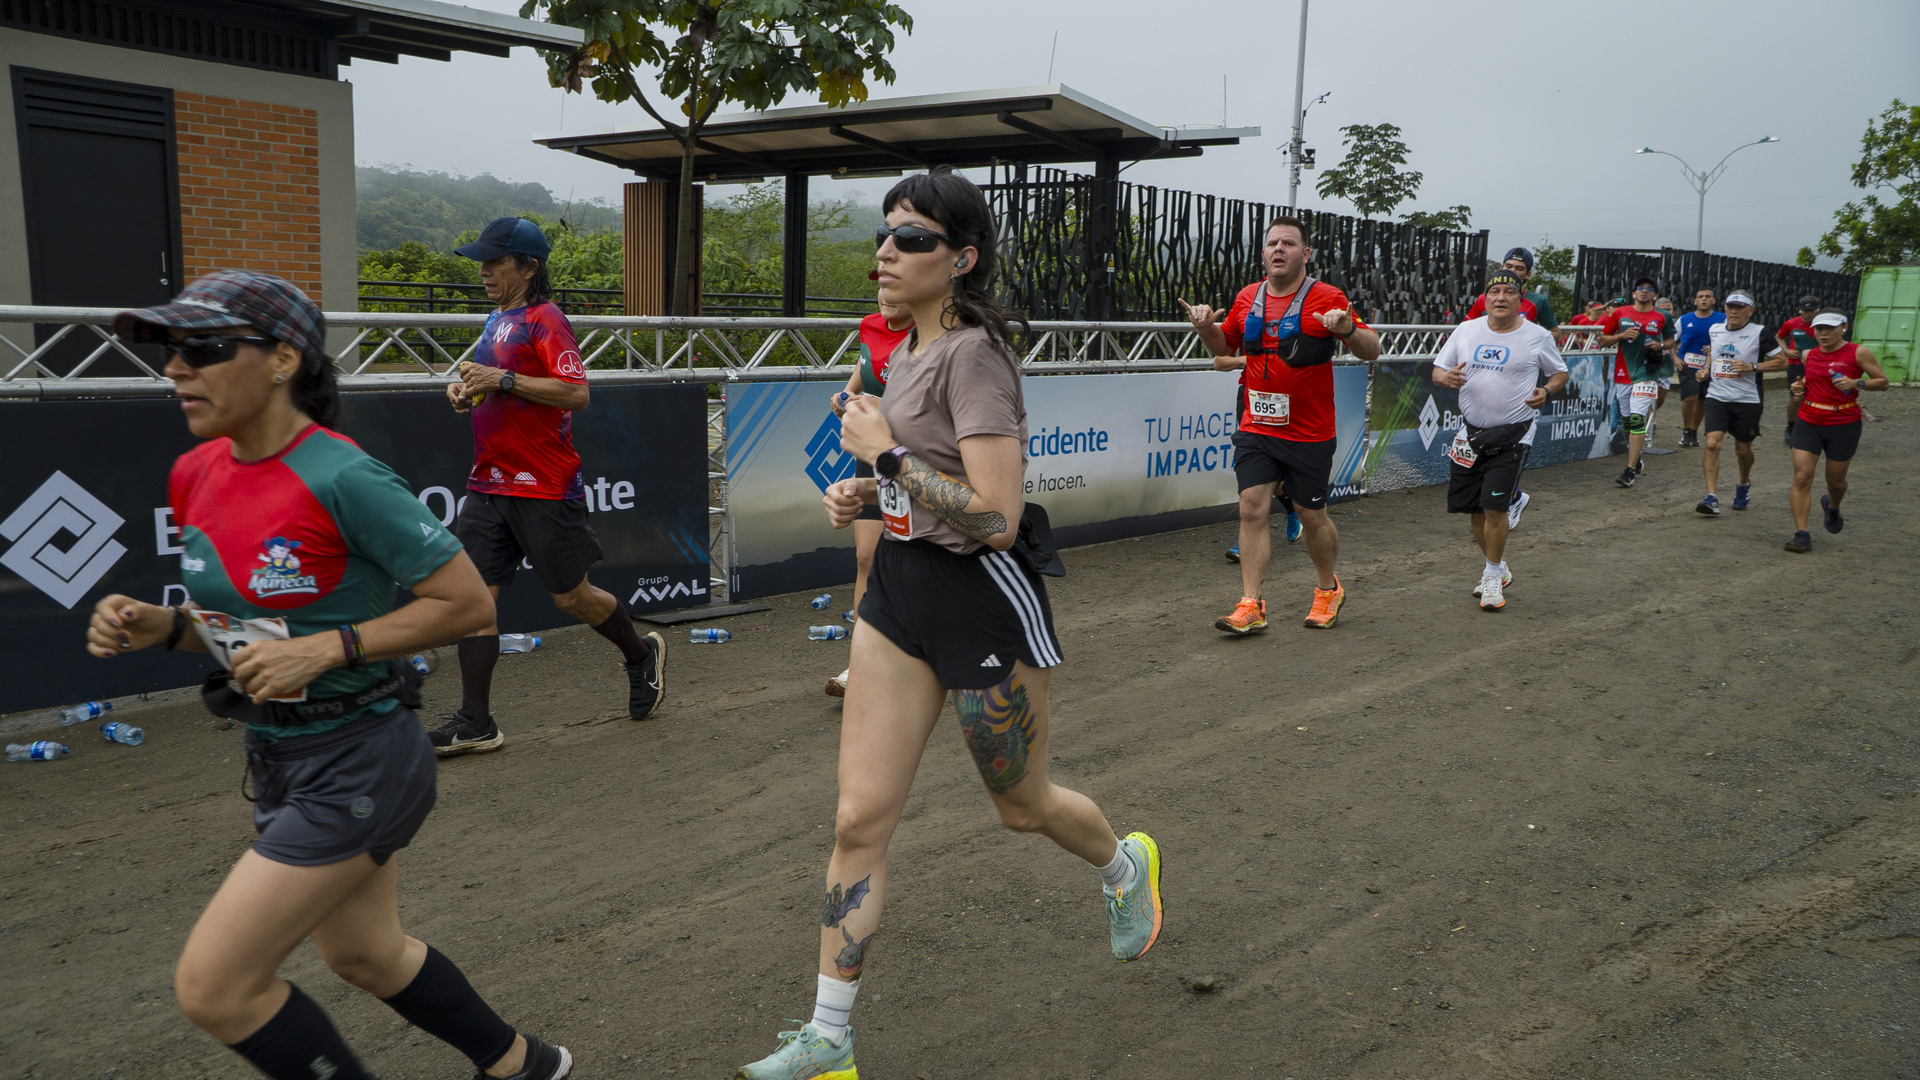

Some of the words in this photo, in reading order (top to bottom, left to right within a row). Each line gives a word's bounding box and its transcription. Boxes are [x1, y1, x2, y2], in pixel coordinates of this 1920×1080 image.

[1472, 363, 1504, 372] RUNNERS
[1254, 401, 1276, 414] 695
[1551, 400, 1564, 417] TU
[1145, 417, 1171, 443] TU
[1551, 418, 1598, 441] IMPACTA.
[1027, 426, 1108, 457] cidente
[1038, 473, 1086, 492] hacen.
[1329, 485, 1359, 497] AVAL
[638, 575, 669, 586] Grupo
[628, 579, 707, 606] AVAL
